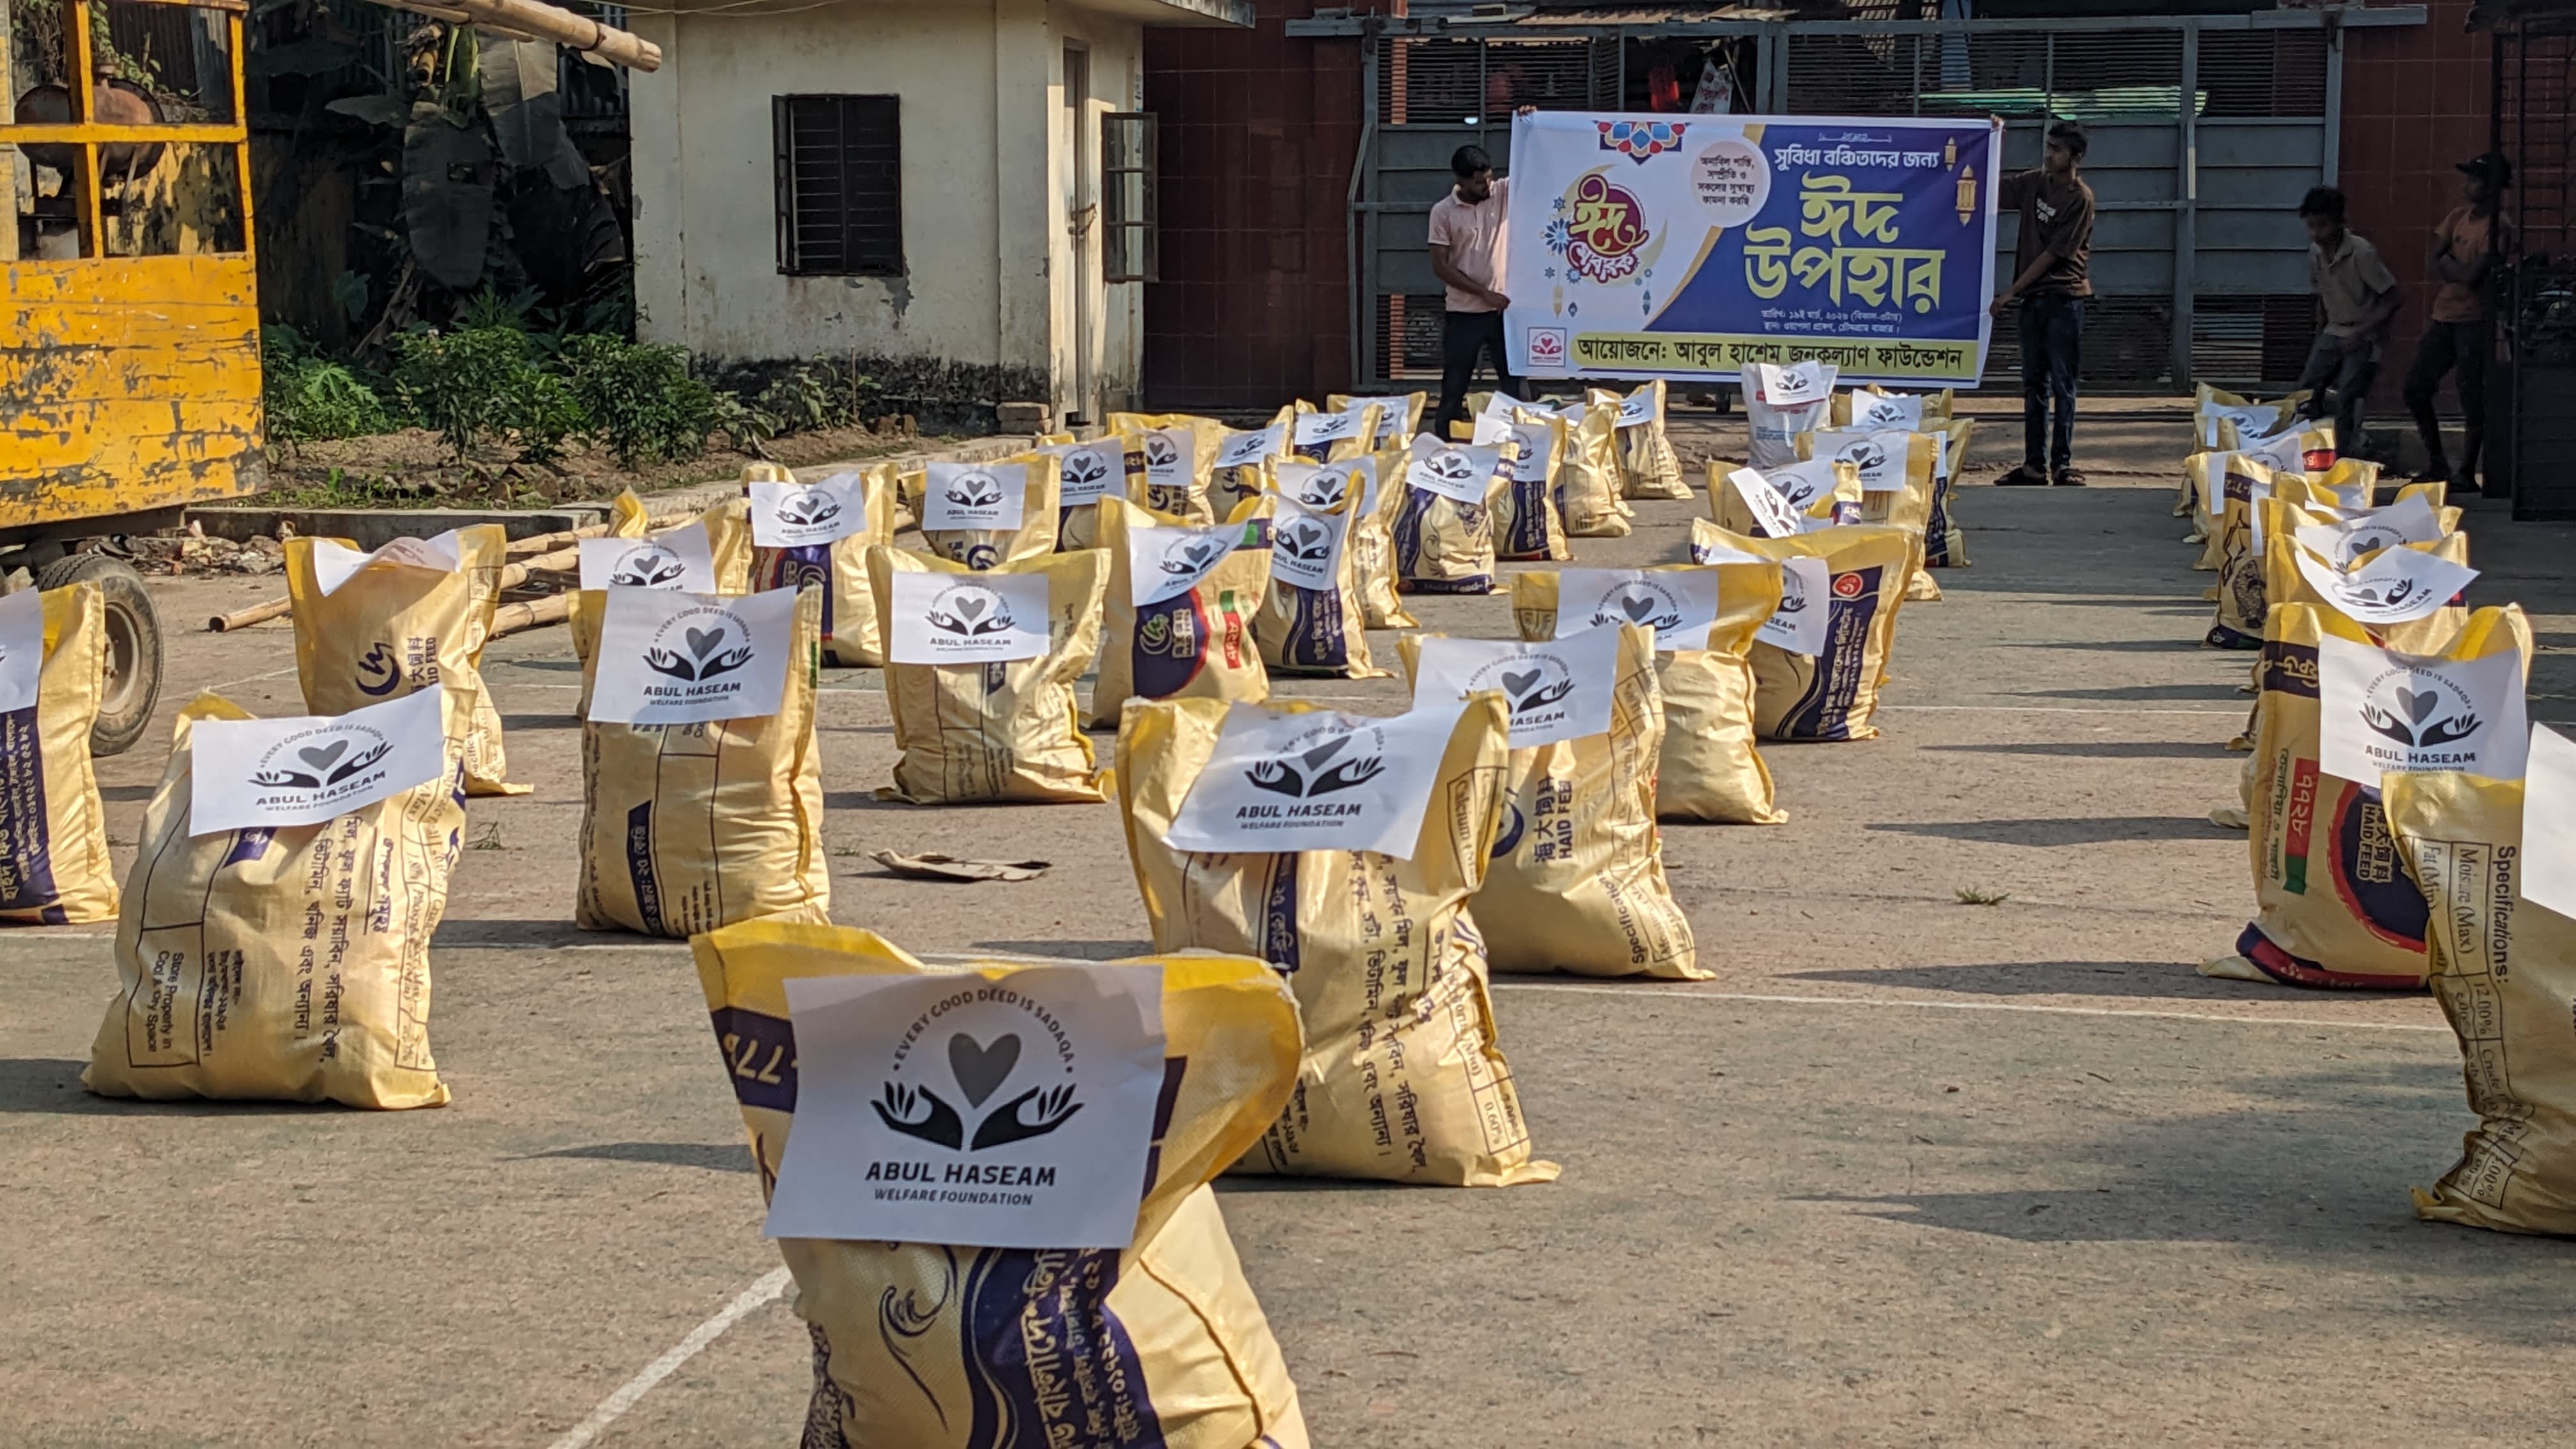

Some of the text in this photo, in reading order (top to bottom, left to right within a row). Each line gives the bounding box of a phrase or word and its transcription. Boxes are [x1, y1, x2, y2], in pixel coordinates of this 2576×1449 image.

[1774, 144, 1940, 171] সুবিধা বঞ্চিতদের জন্য
[1570, 176, 1648, 256] ঈদ
[1799, 171, 1903, 246] ঈদ
[1742, 224, 1946, 314] উপহার
[1577, 339, 1963, 371] আয়োজনে: আবুল হাশেম জনকল্যাণ ফাউন্ডেশন
[425, 637, 436, 663] FEED
[930, 638, 961, 646] ABUL
[643, 682, 742, 697] ABUL HASEAM
[284, 730, 313, 744] GOOD
[2365, 745, 2476, 763] ABUL HASEAM
[256, 770, 386, 806] ABUL HASEAM
[1236, 803, 1362, 819] ABUL HASEAM
[1557, 820, 1572, 859] HAID
[2359, 806, 2376, 878] HAID FEED
[2422, 844, 2442, 863] Fat
[305, 838, 334, 894] ভিটামিন,
[2453, 906, 2476, 954] (Max)
[2492, 845, 2517, 984] Specifications:
[153, 950, 170, 976] Cool
[299, 944, 314, 975] এবং
[160, 951, 185, 1049] Store Properly in
[323, 973, 344, 1025] সরিষার
[1360, 949, 1385, 1017] ভিটামিন,
[295, 979, 312, 1030] অন্যান্য
[2473, 983, 2492, 1035] 12.00%
[145, 1013, 158, 1052] Space
[895, 987, 1075, 1062] EVERY GOOD DEED IS SADAQA
[1360, 1059, 1379, 1093] এবং
[1483, 1100, 1504, 1146] 0.60%
[865, 1162, 1057, 1187] ABUL HASEAM
[873, 1188, 1033, 1206] WELFARE FOUNDATION
[1099, 1326, 1126, 1393] ০১৭২২
